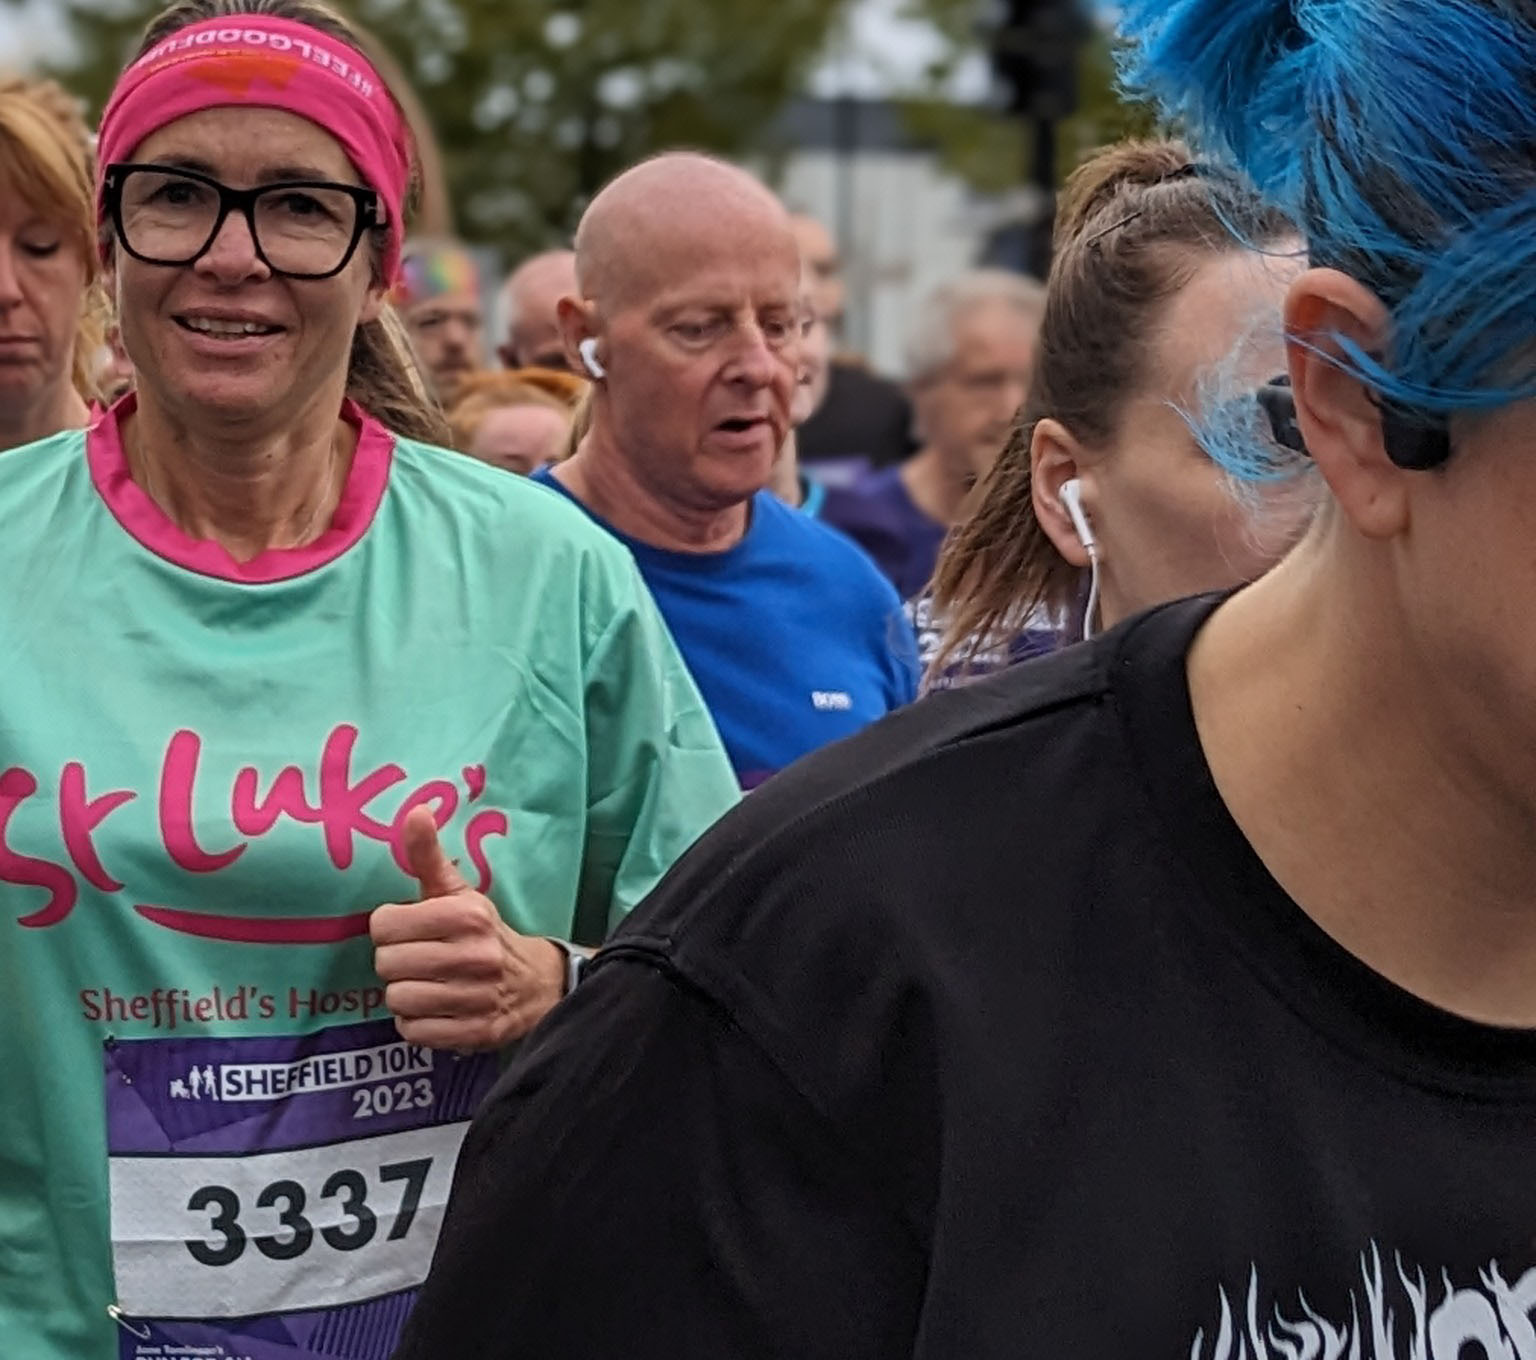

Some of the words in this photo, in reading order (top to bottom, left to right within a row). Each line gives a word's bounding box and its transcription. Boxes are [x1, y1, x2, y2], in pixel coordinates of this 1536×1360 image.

[160, 723, 508, 896] Luke's
[79, 986, 275, 1029] Sheffield's
[289, 985, 386, 1019] Hosp
[225, 1055, 372, 1096] SHEFFIELD
[378, 1045, 428, 1075] 10K
[353, 1078, 434, 1118] 2023
[184, 1157, 434, 1266] 3337
